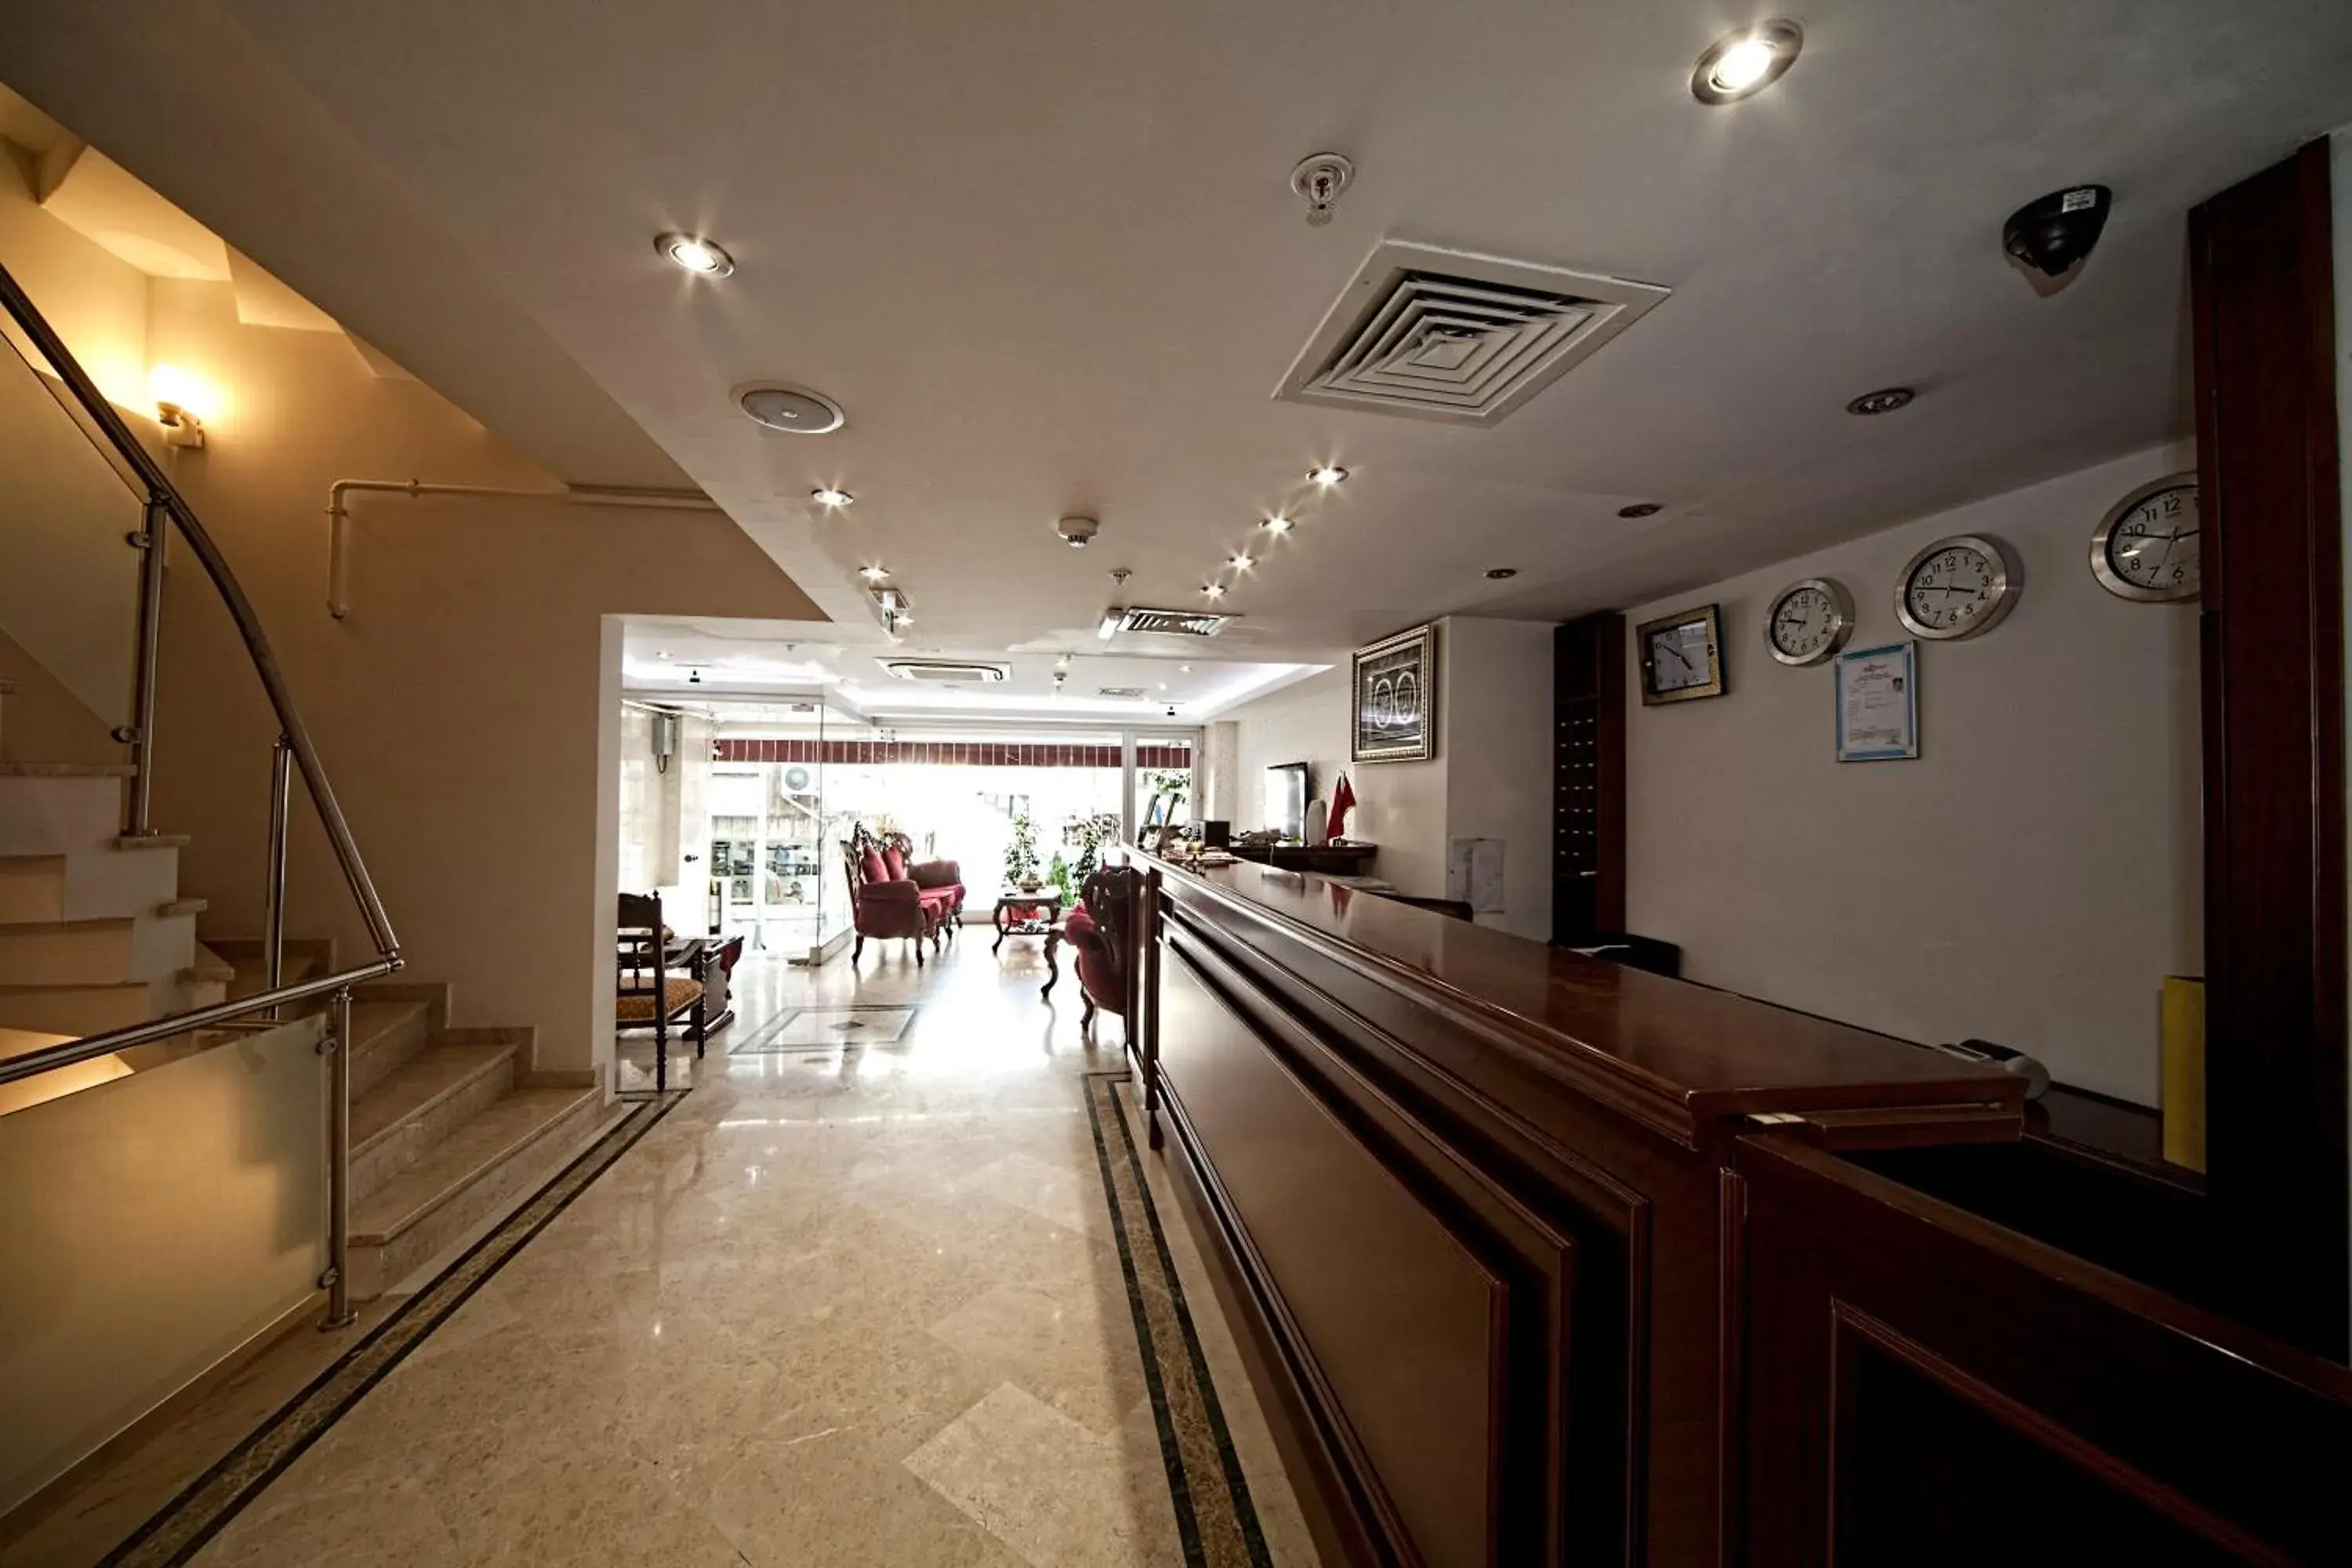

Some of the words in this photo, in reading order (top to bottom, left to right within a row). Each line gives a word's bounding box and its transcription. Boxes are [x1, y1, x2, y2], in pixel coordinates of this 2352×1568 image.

[2164, 497, 2181, 512] 12
[2145, 508, 2157, 522] 11
[2129, 523, 2146, 536] 10
[1944, 556, 1956, 567] 12
[1964, 556, 1969, 567] 1
[1976, 561, 1984, 572] 2
[2130, 557, 2141, 571] 8
[1933, 564, 1940, 574] 11
[2148, 565, 2161, 579] 7
[2173, 566, 2184, 579] 6
[1922, 575, 1933, 586] 10
[1981, 575, 1989, 587] 3
[1917, 591, 1925, 602] 9
[1922, 603, 1929, 614] 8
[1965, 603, 1974, 615] 5
[1934, 610, 1941, 621] 7
[1949, 610, 1958, 622] 6
[1782, 633, 1788, 642] 8
